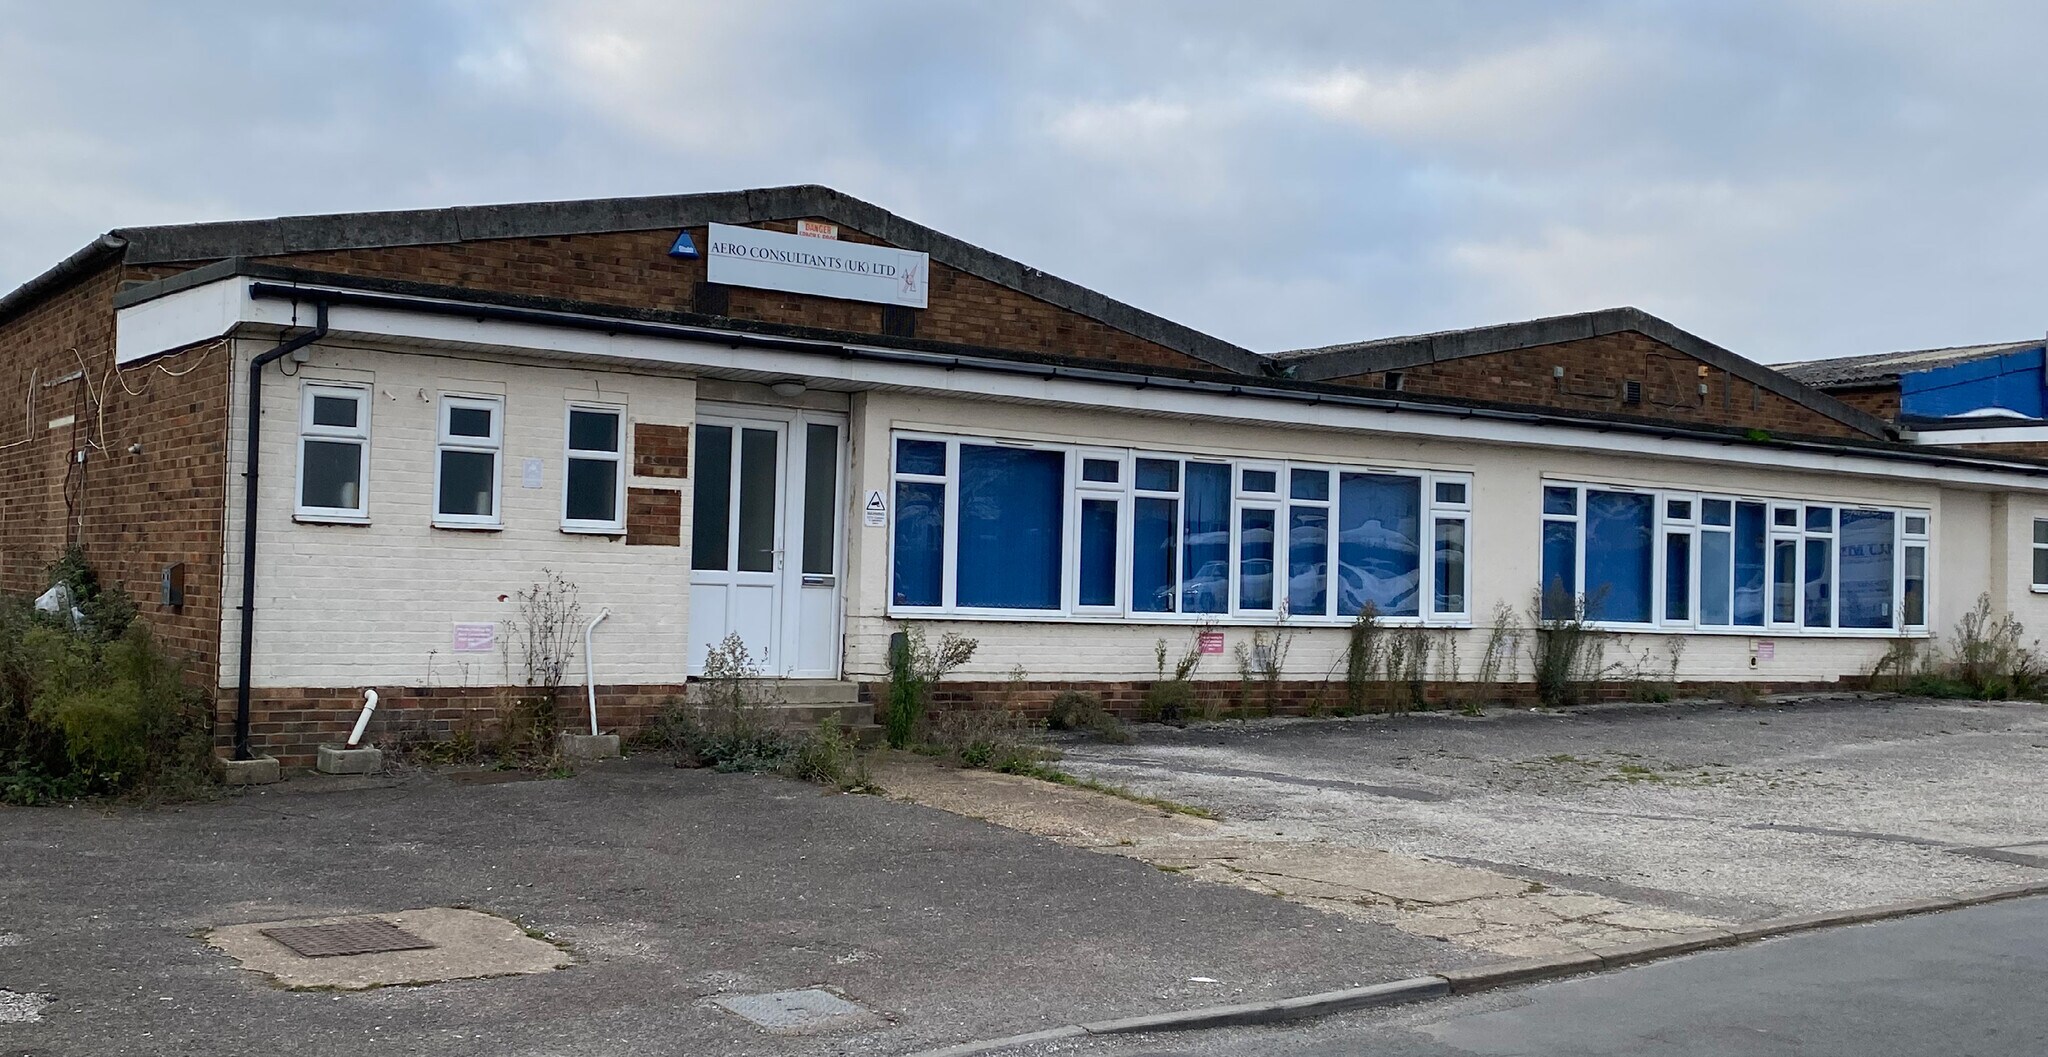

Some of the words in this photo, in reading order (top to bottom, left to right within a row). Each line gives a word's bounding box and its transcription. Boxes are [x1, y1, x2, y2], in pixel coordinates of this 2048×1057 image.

[805, 222, 832, 235] DANGER
[711, 242, 747, 257] AERO
[750, 246, 842, 269] CONSULTANTS
[844, 259, 870, 274] (UK)
[873, 263, 896, 277] LTD
